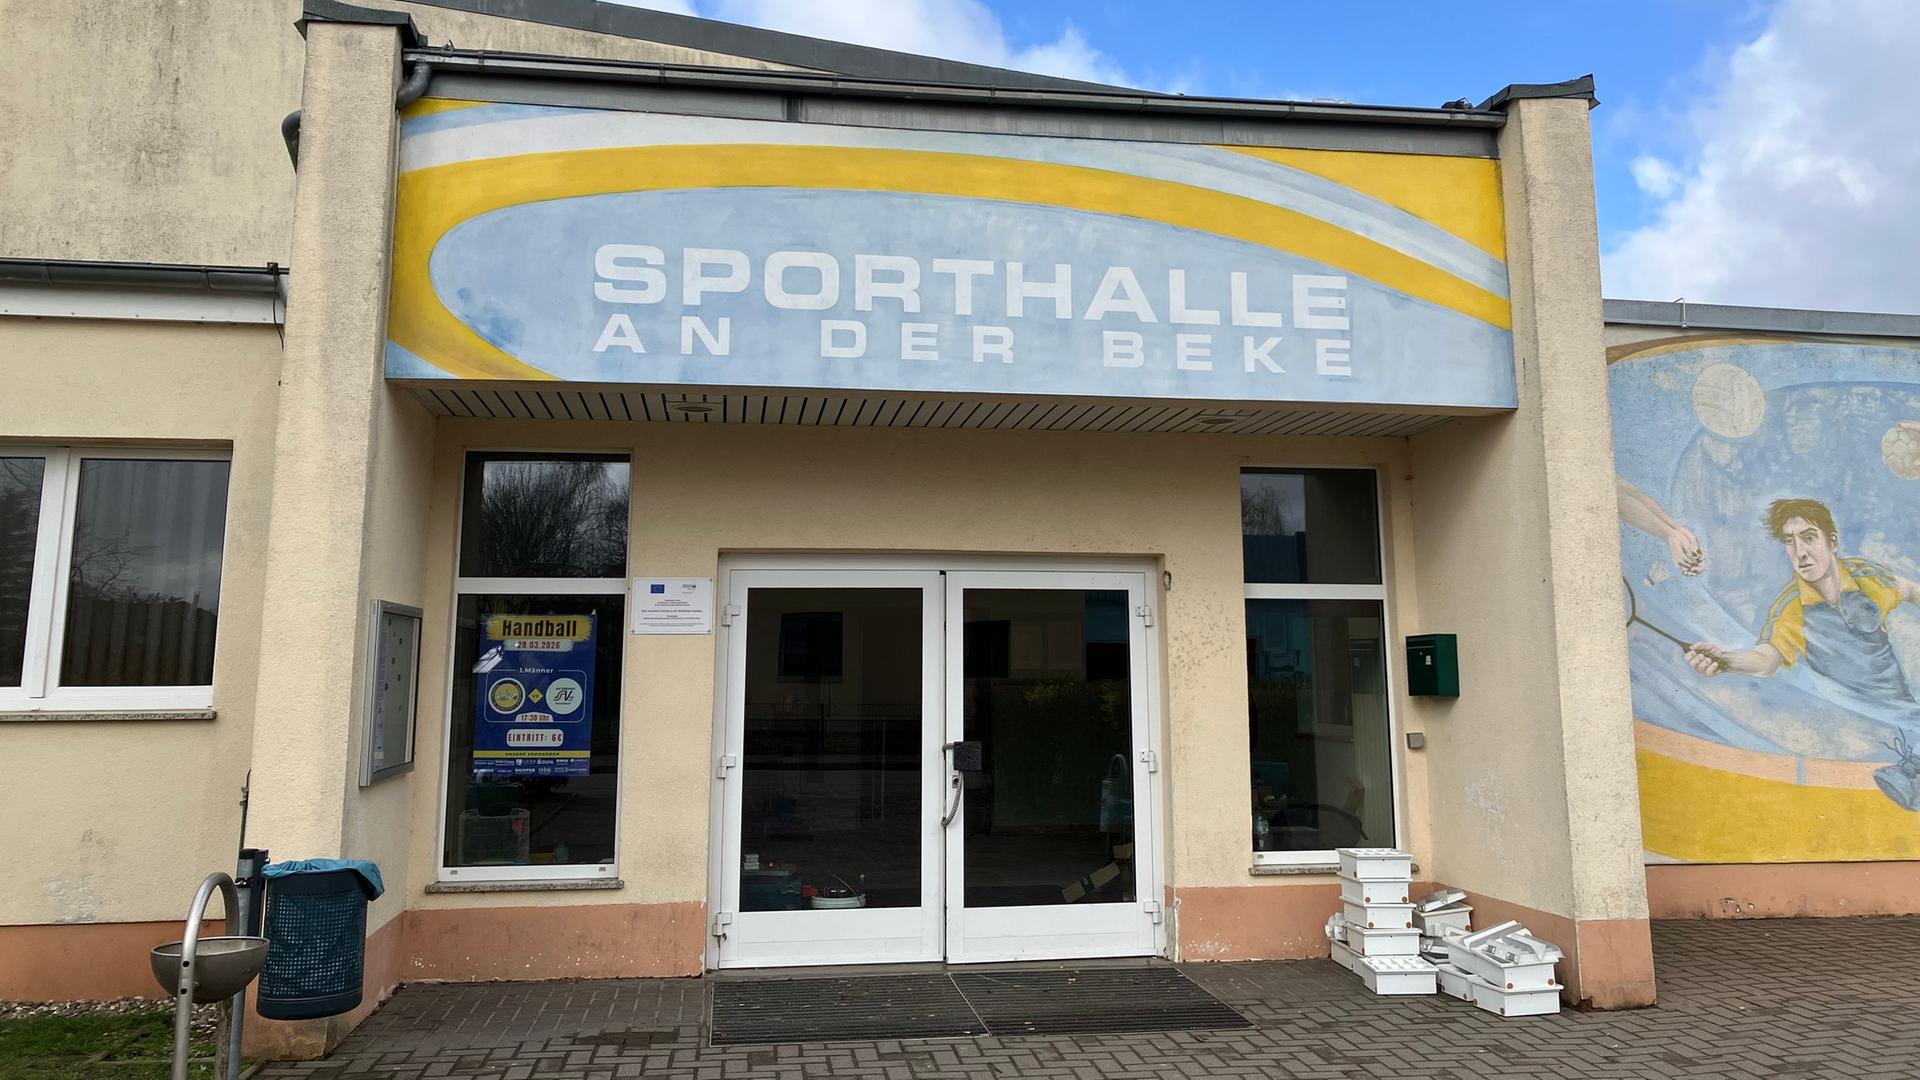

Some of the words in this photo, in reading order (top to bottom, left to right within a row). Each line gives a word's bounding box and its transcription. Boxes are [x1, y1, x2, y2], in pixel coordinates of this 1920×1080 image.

[594, 243, 1350, 330] SPORTHALLE
[592, 313, 730, 356] AN
[820, 319, 1014, 364] DER
[1103, 331, 1352, 376] BEKE
[502, 619, 577, 637] Handball
[517, 641, 560, 649] 28.03.2026
